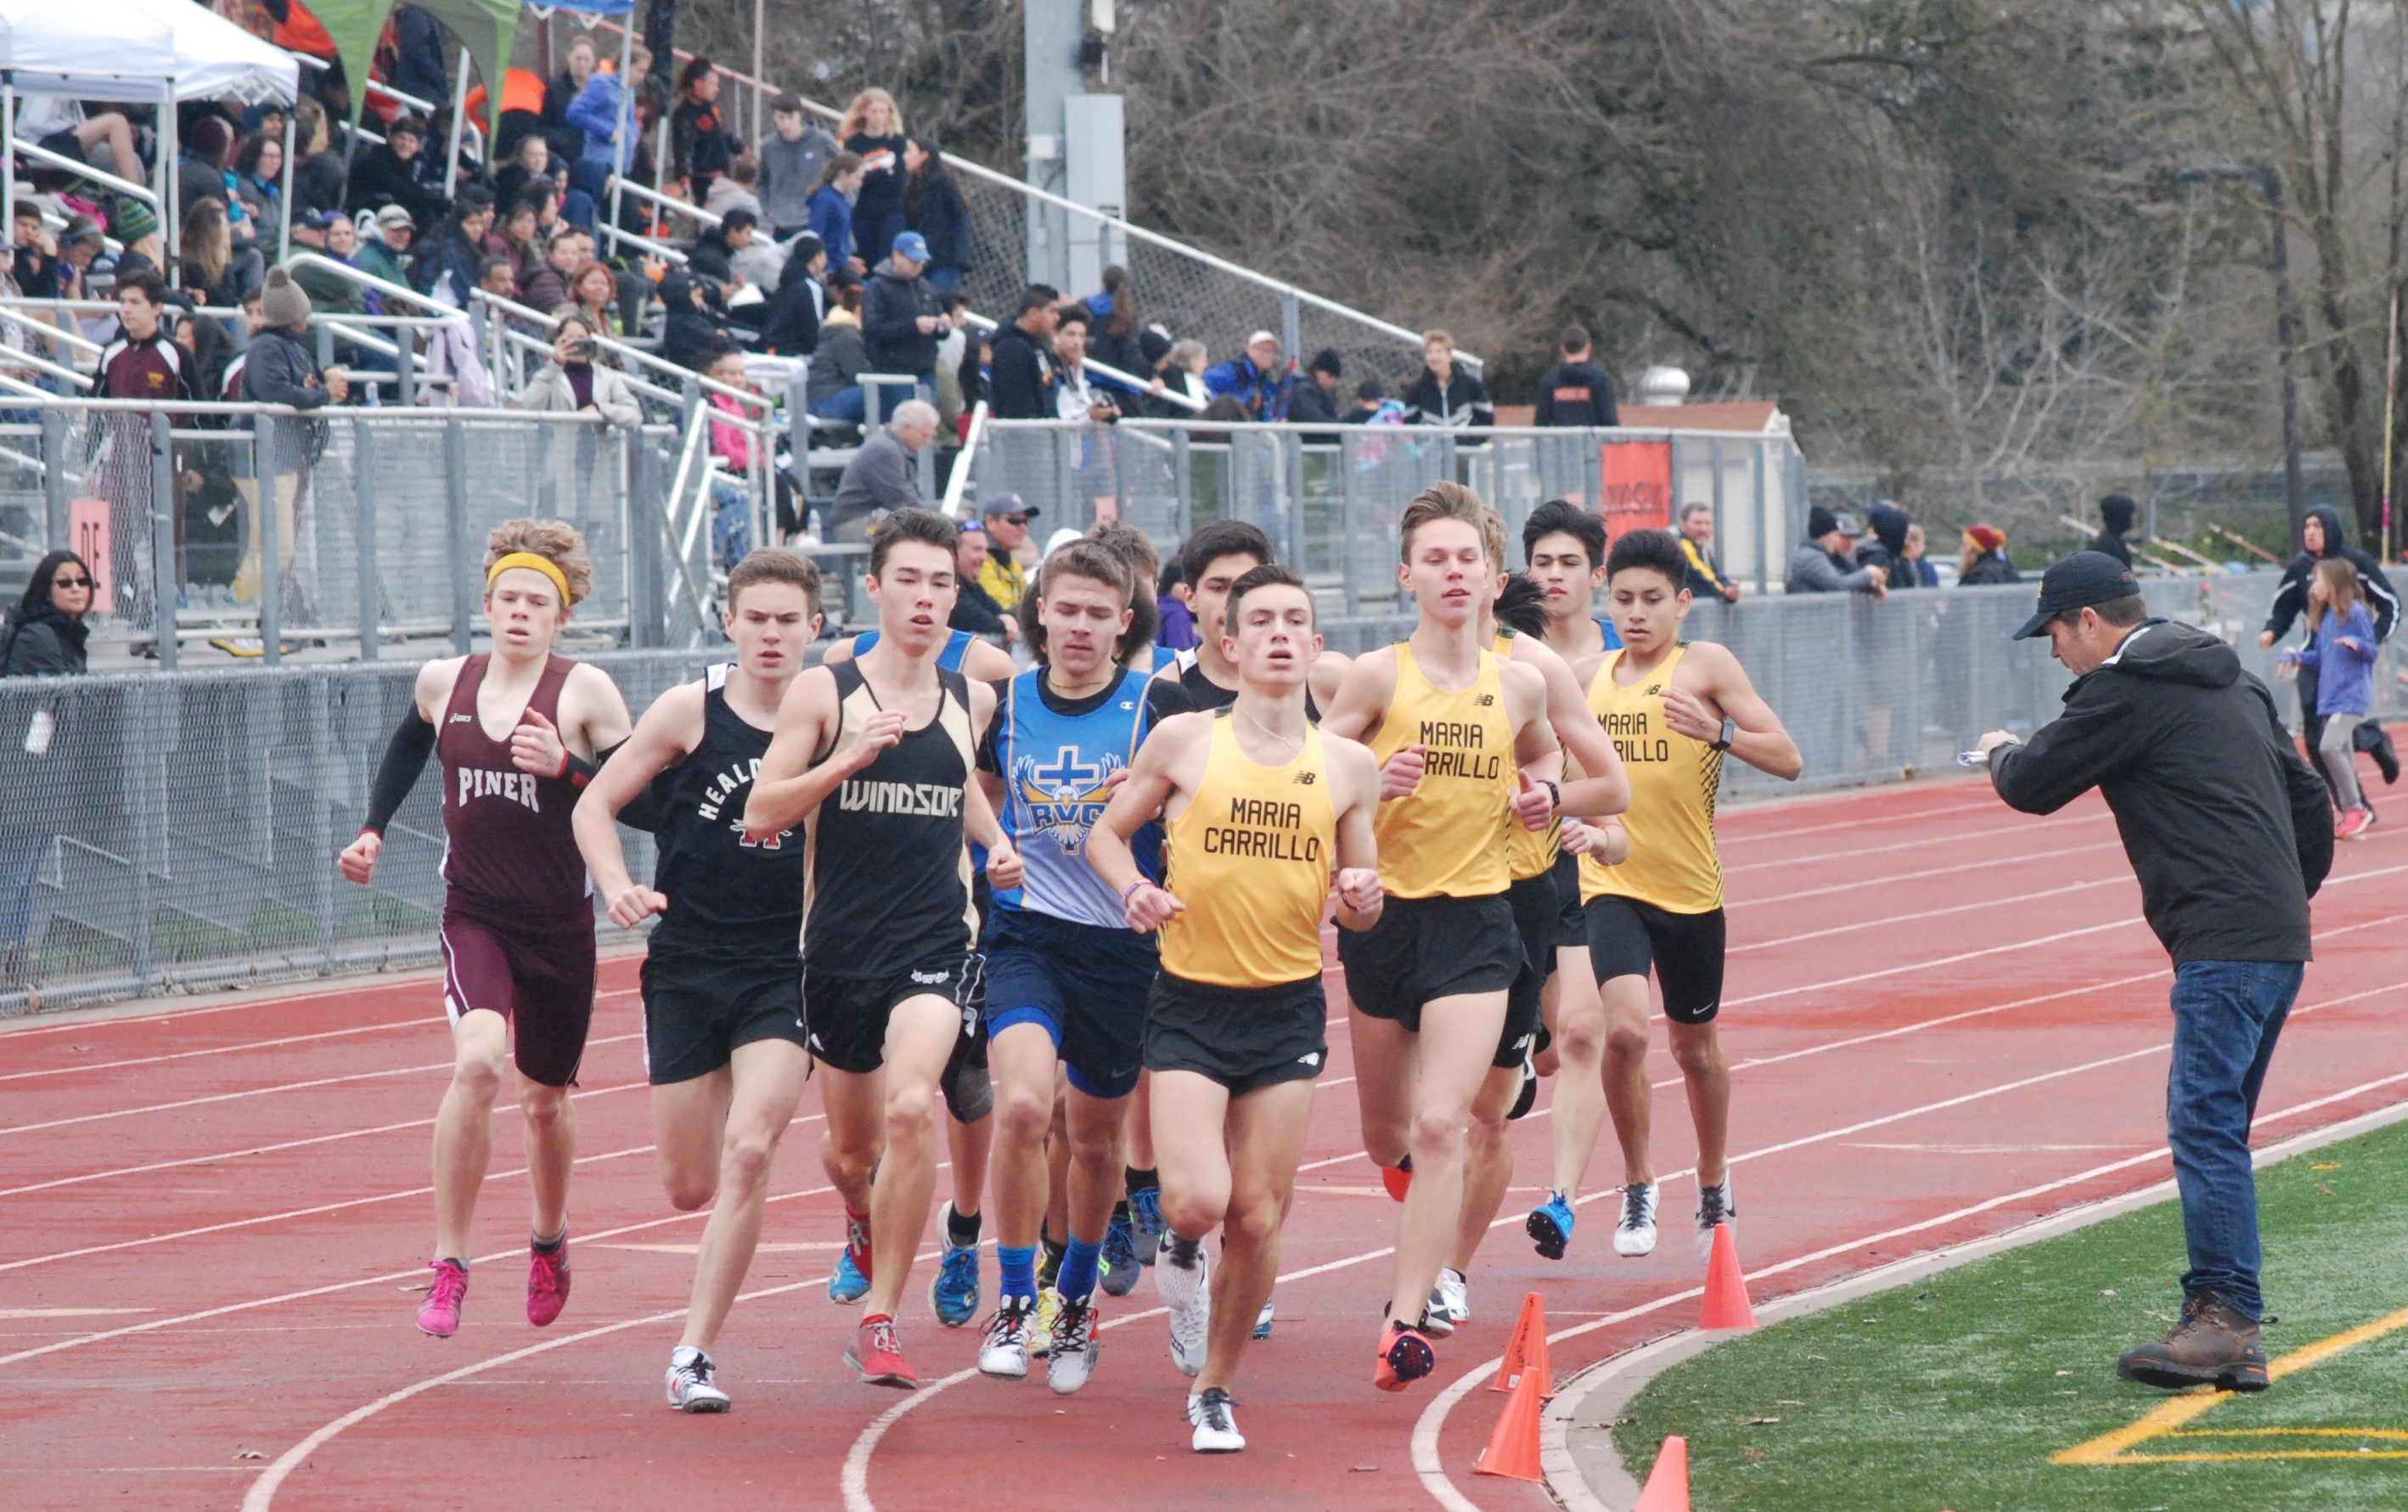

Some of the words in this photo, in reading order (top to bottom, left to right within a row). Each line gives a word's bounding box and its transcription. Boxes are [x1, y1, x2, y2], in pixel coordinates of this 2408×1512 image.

[1420, 721, 1482, 749] MARIA
[459, 767, 539, 813] PINER
[839, 779, 963, 818] WINDSOR
[1230, 797, 1301, 829] MARIA
[1204, 827, 1319, 863] CARRILLO
